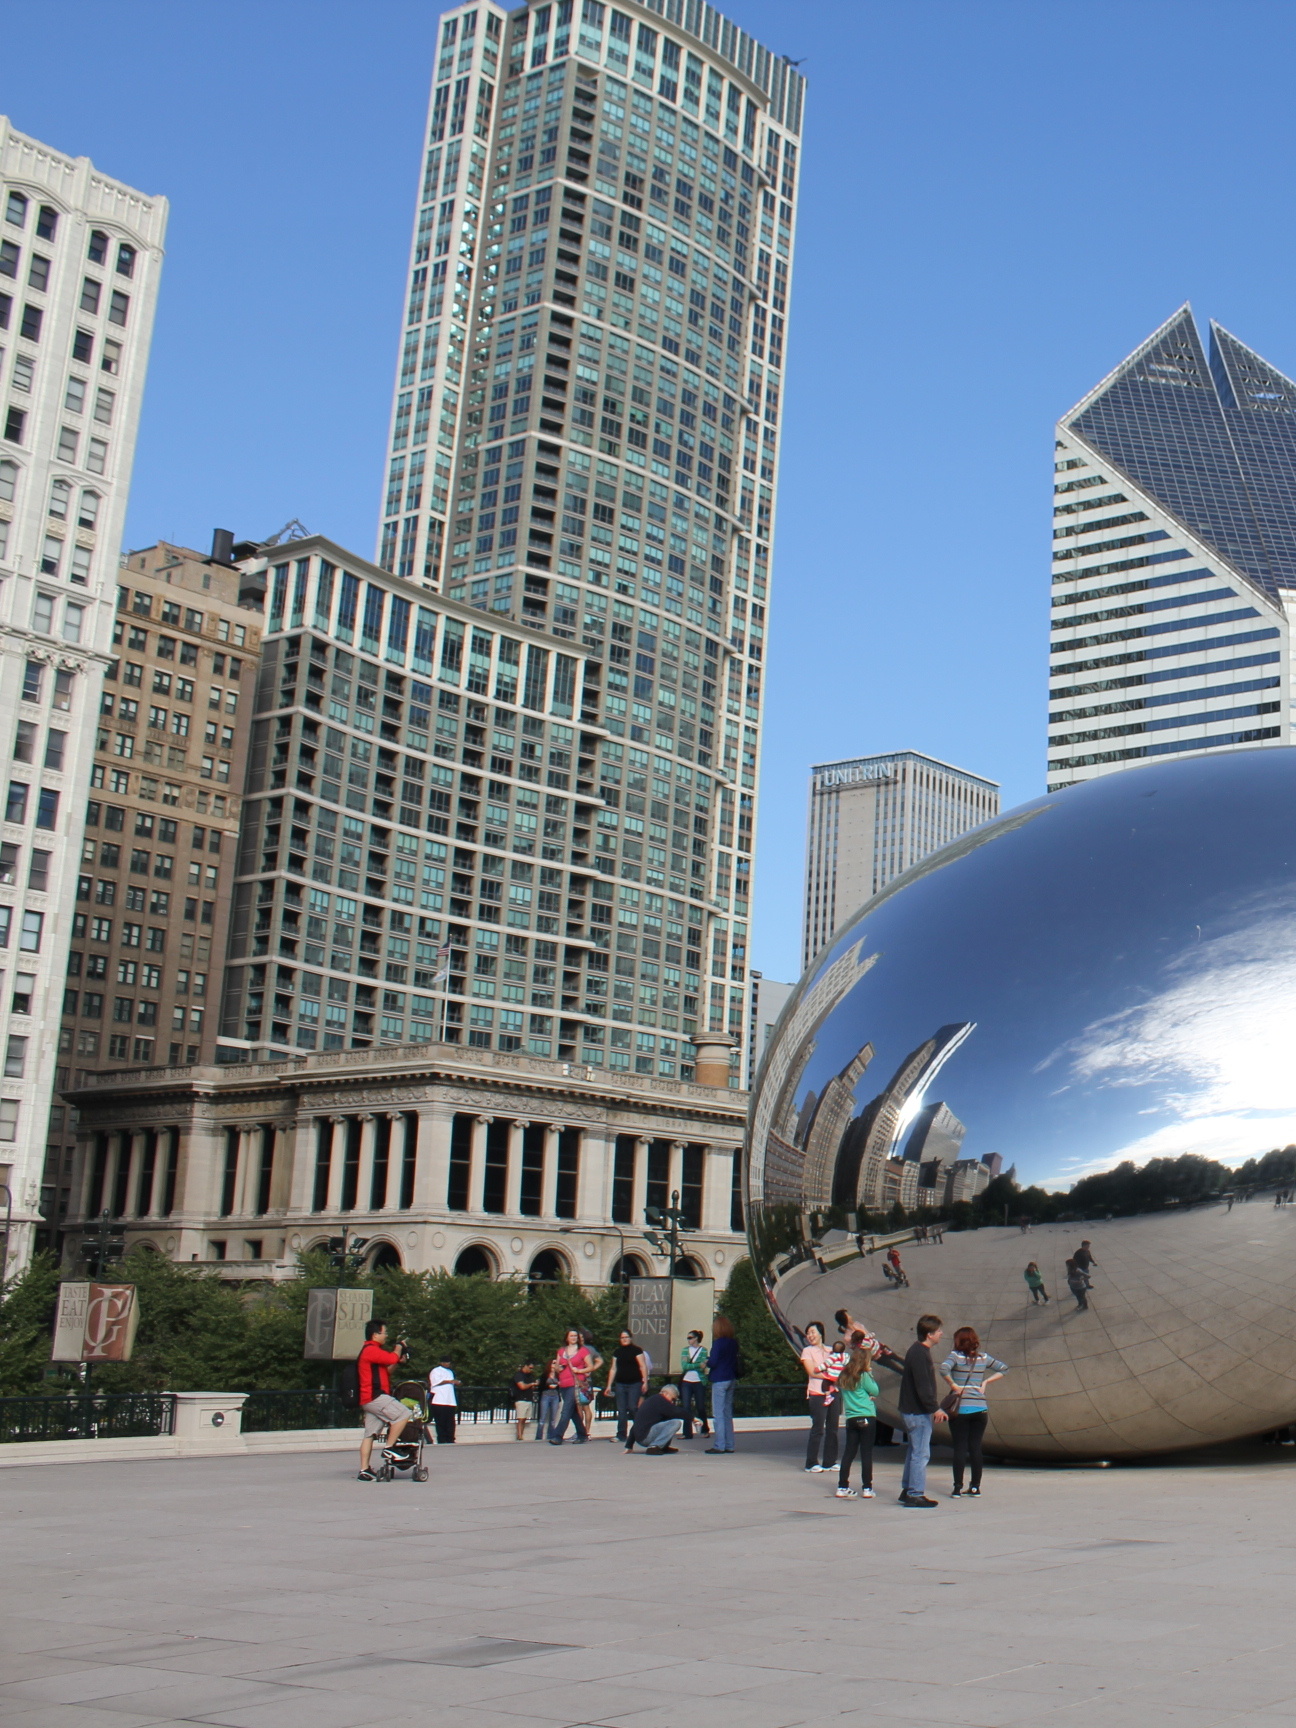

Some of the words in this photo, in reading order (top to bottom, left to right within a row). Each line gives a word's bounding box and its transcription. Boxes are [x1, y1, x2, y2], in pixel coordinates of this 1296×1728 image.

[824, 763, 891, 787] UNITRIN
[656, 1117, 695, 1129] LIBRARY
[702, 1124, 713, 1132] OF
[720, 1126, 738, 1137] THE
[63, 1286, 88, 1298] TASTE
[340, 1292, 371, 1302] SHARE
[633, 1284, 669, 1302] PLAY
[61, 1300, 87, 1316] EAT
[338, 1302, 370, 1321] SIP
[632, 1303, 668, 1315] DREAM
[59, 1317, 83, 1330] ENJOY
[631, 1318, 667, 1335] DINE
